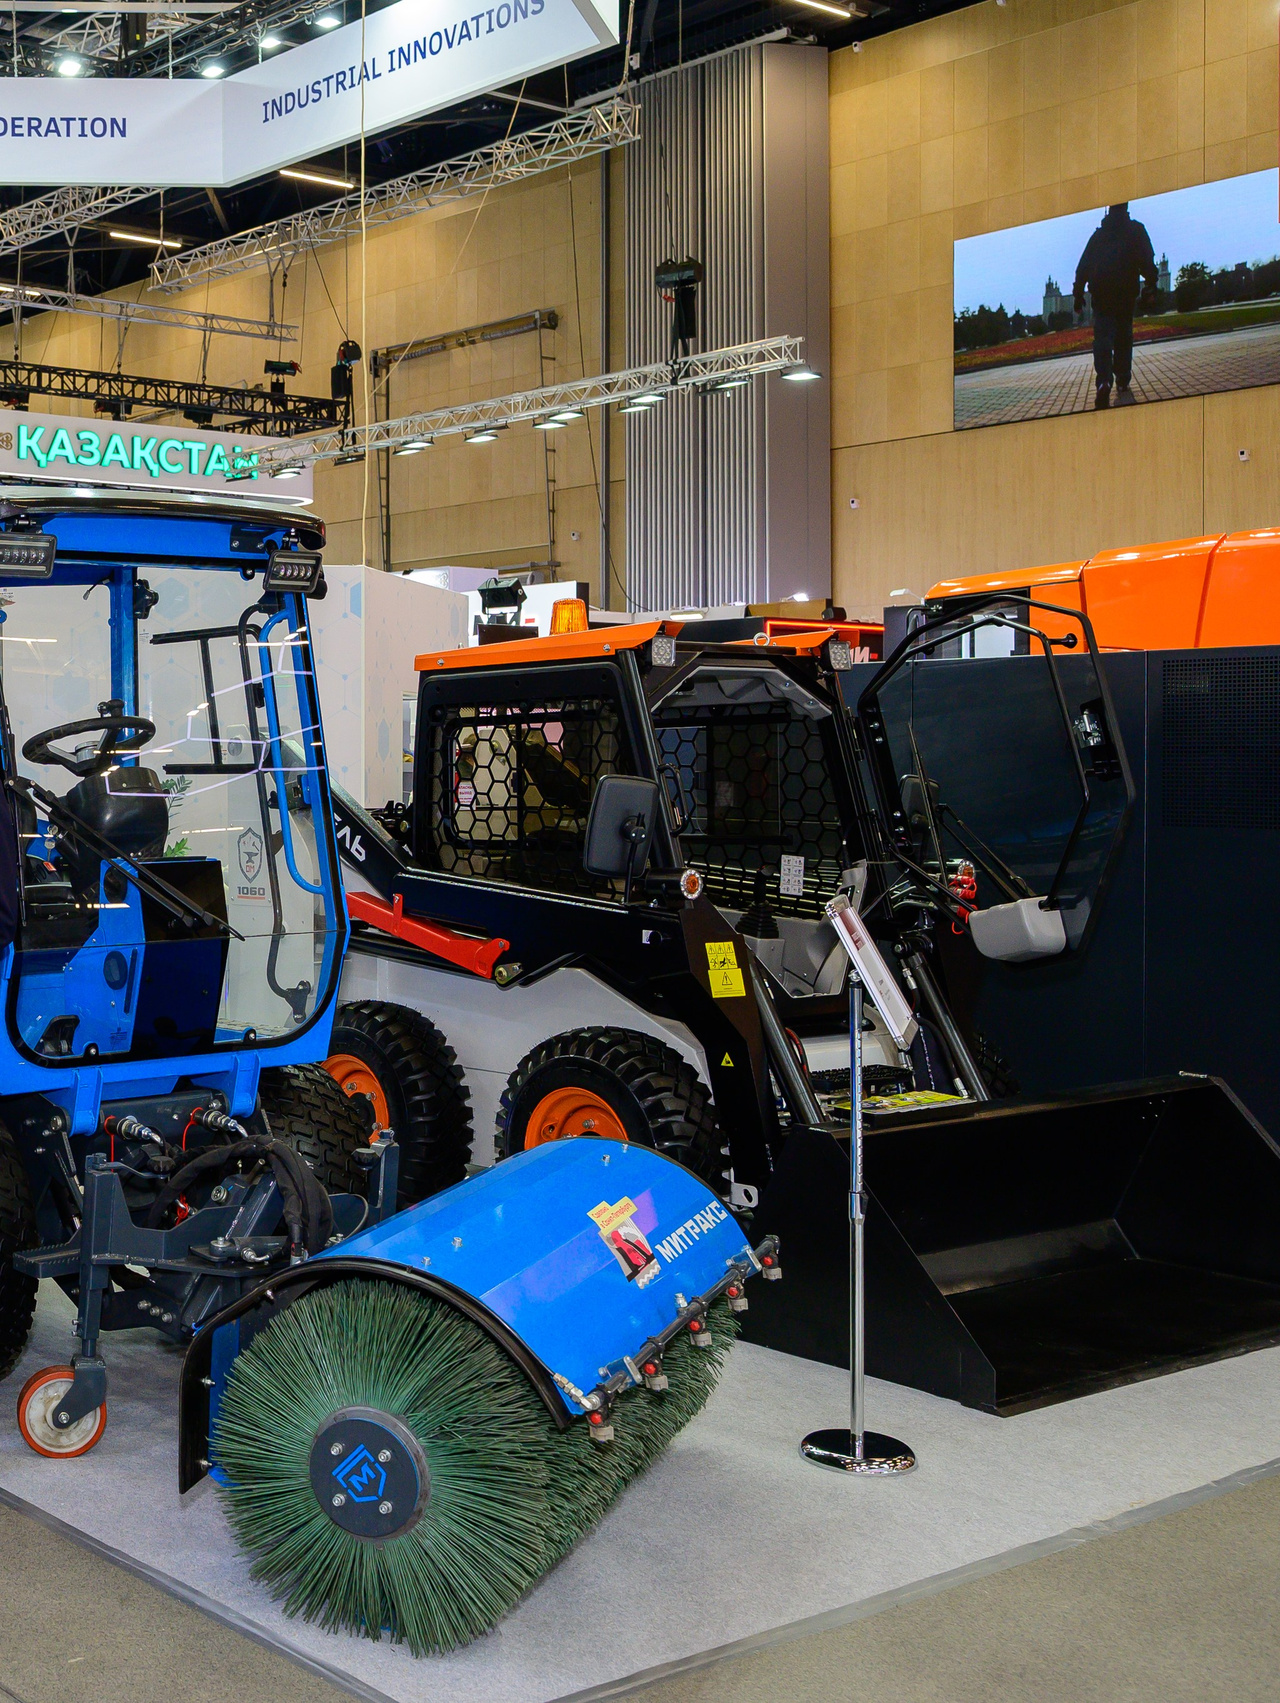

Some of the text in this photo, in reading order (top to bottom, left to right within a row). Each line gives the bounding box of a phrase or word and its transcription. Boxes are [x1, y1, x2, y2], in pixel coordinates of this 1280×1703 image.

[262, 0, 545, 124] INDUSTRIAL INNOVATIONS
[237, 886, 266, 896] 1060
[654, 1200, 729, 1264] МИТРАКС
